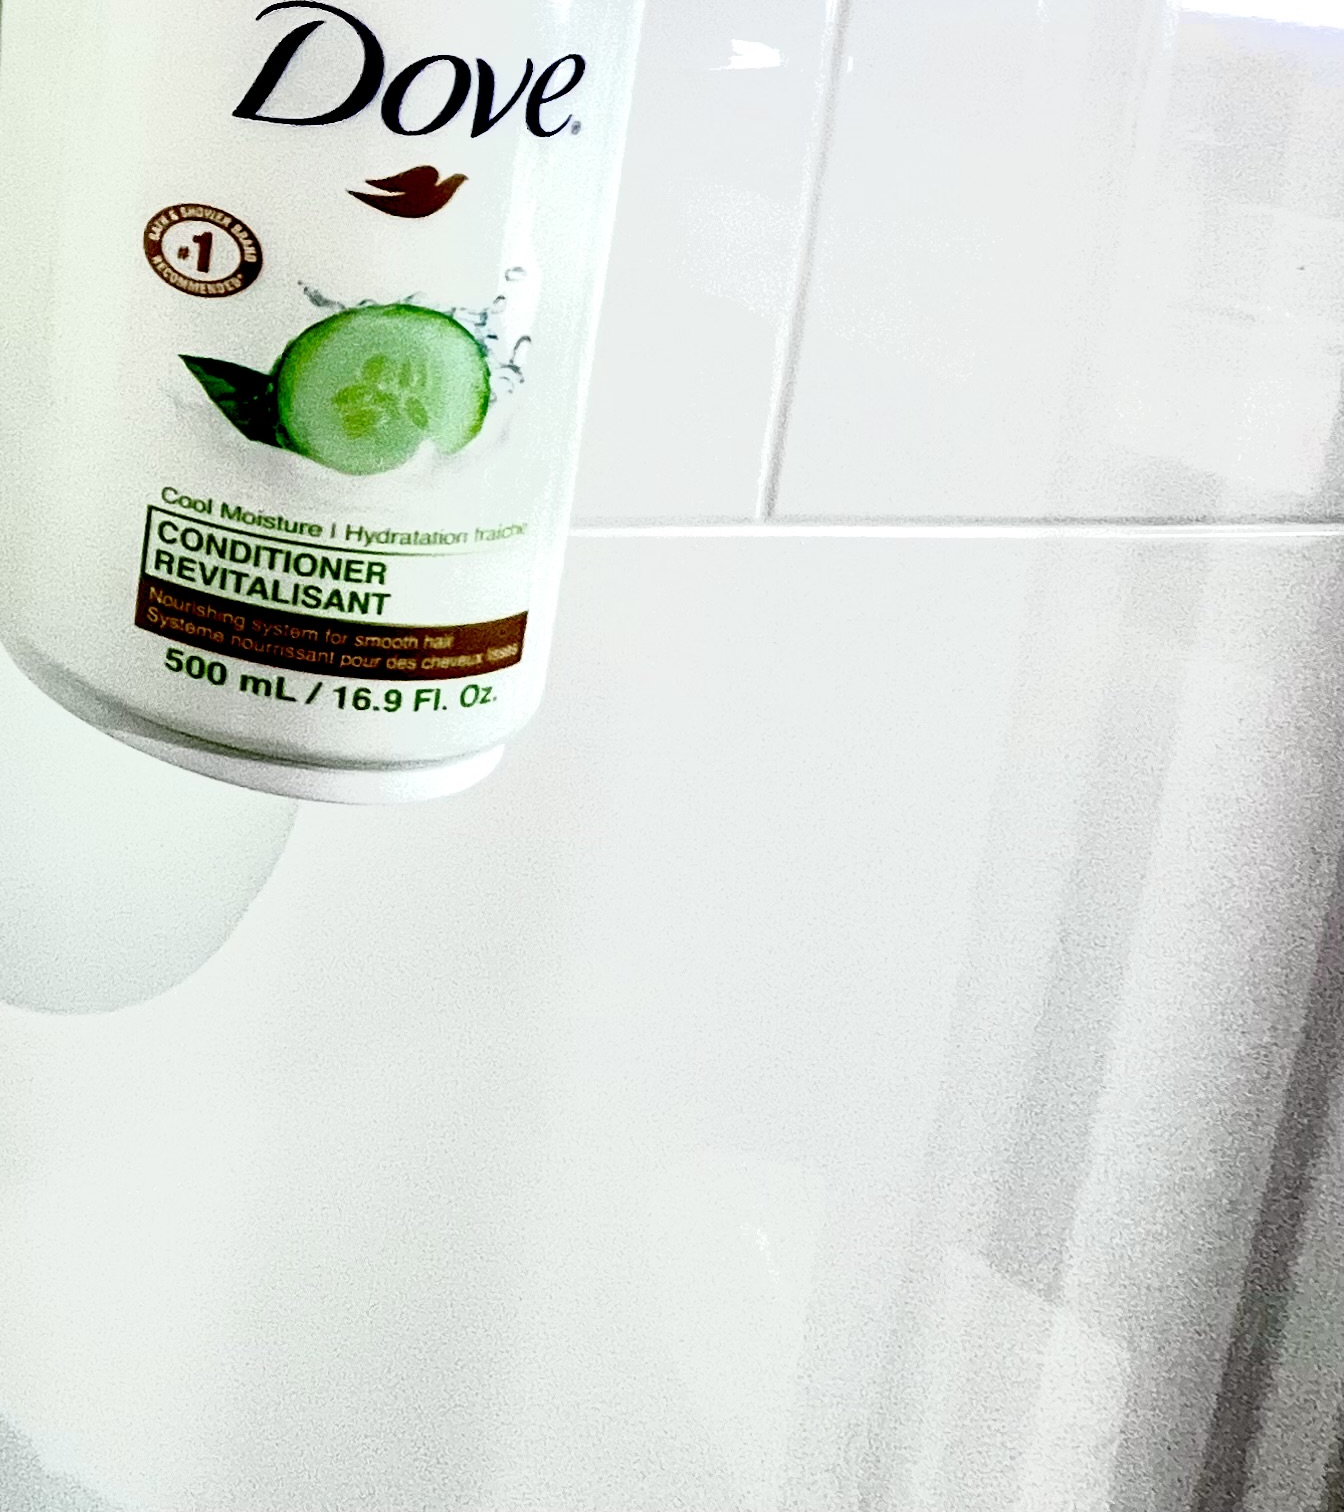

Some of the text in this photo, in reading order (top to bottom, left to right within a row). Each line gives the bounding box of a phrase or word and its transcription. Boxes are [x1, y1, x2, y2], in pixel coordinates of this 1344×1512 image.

[232, 0, 586, 138] Dove
[161, 486, 213, 515] Cool
[220, 501, 324, 538] Moisture
[345, 524, 469, 548] Hydratation
[154, 548, 392, 616] REVITALISANT
[157, 520, 388, 586] CONDITIONER
[149, 586, 455, 650] Nourishing system for smooth hair
[164, 646, 498, 713] 500 mL / 16.9 Fl. Oz.
[230, 634, 335, 664] nourrissant
[339, 653, 382, 669] pour
[386, 653, 417, 670] des
